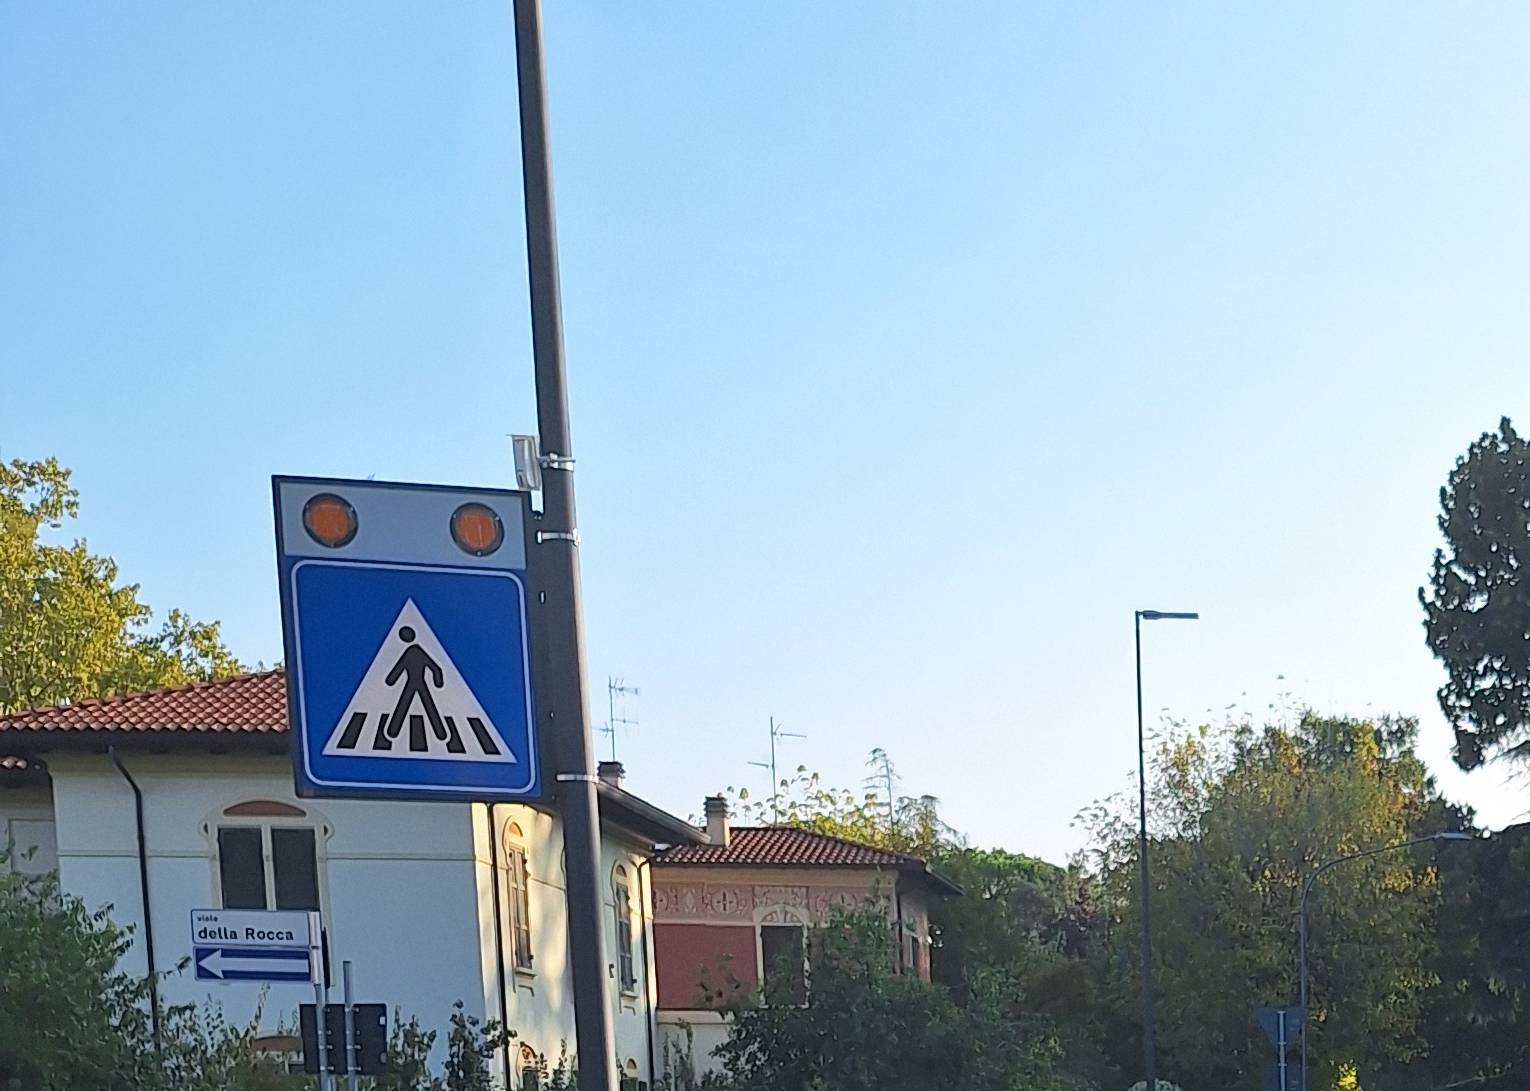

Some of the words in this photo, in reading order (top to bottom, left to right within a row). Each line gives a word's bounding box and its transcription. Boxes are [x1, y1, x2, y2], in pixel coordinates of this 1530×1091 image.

[197, 914, 219, 923] viale
[197, 926, 238, 940] della
[245, 927, 294, 941] Rocca
